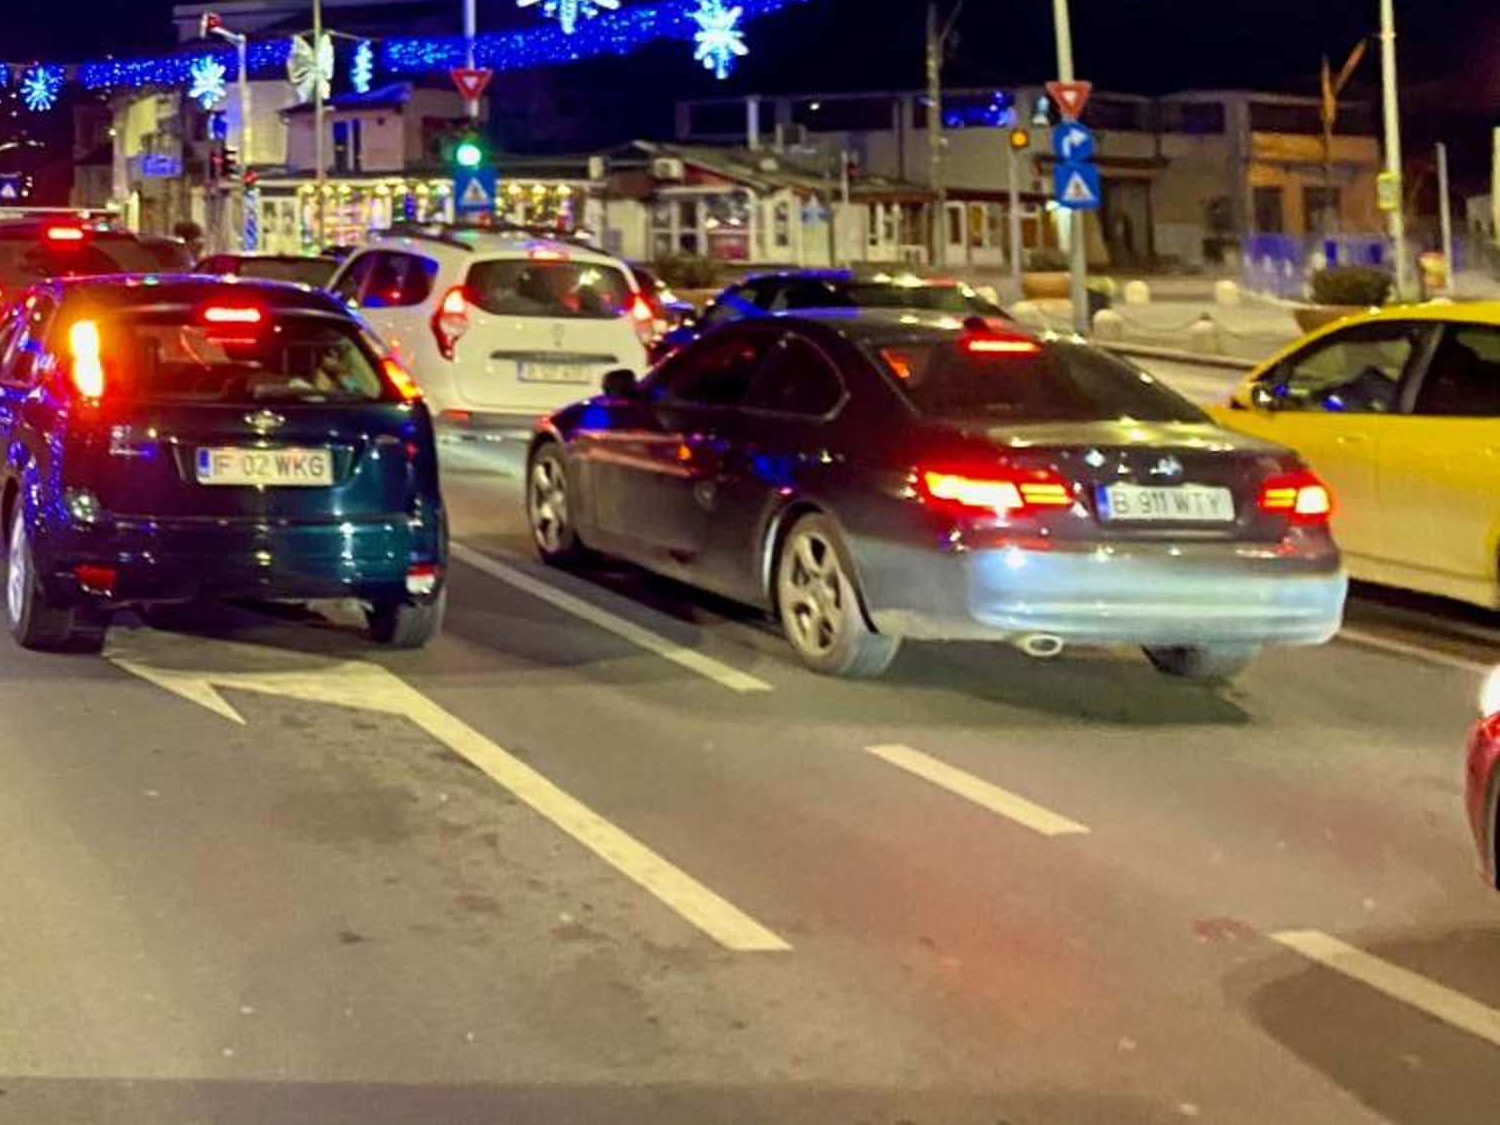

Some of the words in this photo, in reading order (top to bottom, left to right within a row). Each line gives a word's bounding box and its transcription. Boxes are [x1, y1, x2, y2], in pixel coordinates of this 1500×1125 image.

[243, 454, 269, 476] 02
[275, 454, 325, 477] WKG
[1112, 491, 1128, 513] B
[1173, 492, 1221, 515] WTY
